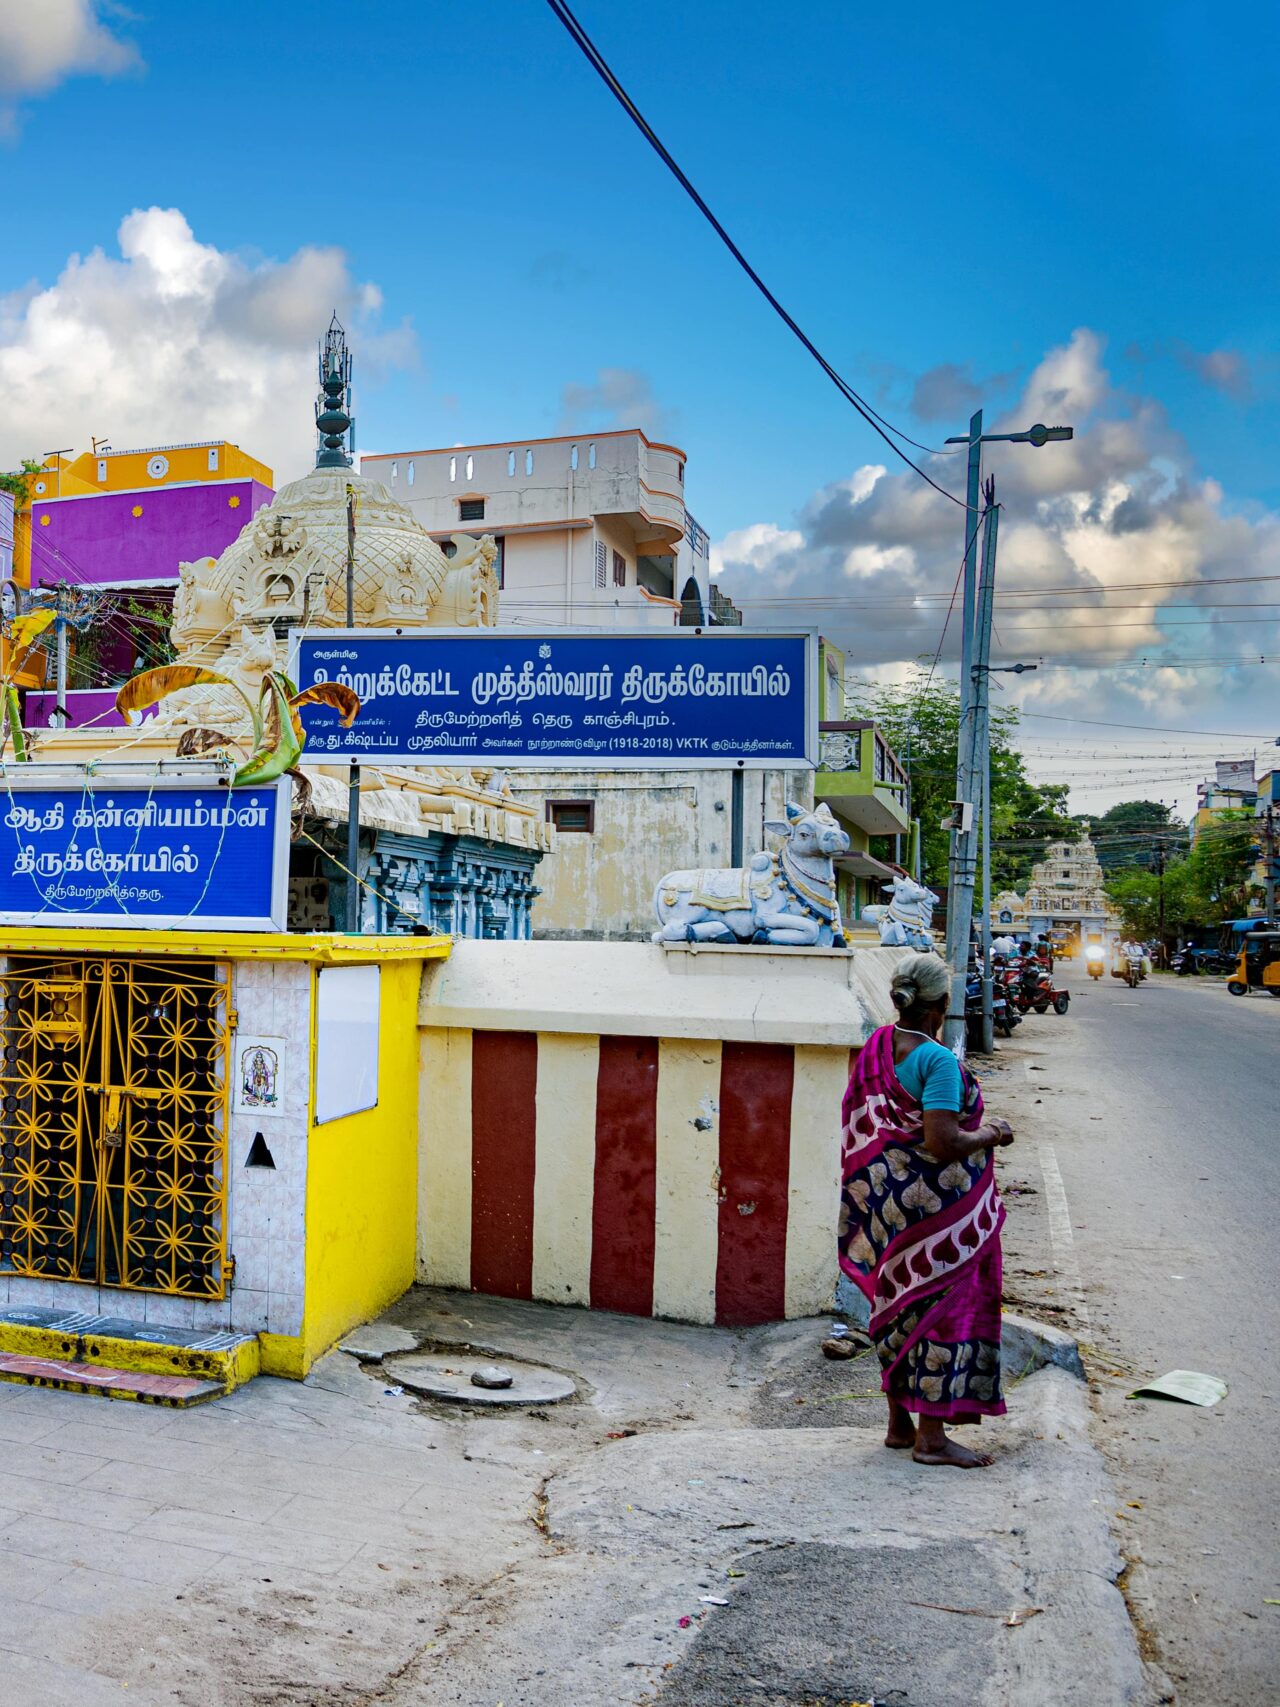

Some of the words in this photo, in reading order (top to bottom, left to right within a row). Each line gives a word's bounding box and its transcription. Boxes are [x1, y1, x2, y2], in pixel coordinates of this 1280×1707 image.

[313, 649, 358, 660] அருள்மிகு
[471, 660, 614, 706] முத்தீஸ்வரர்
[621, 663, 790, 706] திருக்கோயில்
[414, 710, 523, 729] திருமேற்றளித்
[532, 712, 573, 730] தெரு
[582, 710, 676, 730] காஞ்சிபுரம்.
[407, 731, 478, 751] முதலியார்
[481, 737, 523, 748] அவர்கள்
[609, 738, 673, 751] (1918-2018)
[676, 738, 708, 749] VKTK
[4, 801, 65, 833] ஆதி
[72, 797, 269, 830] கன்னியம்மன்
[12, 843, 199, 877] திருக்கோயில்
